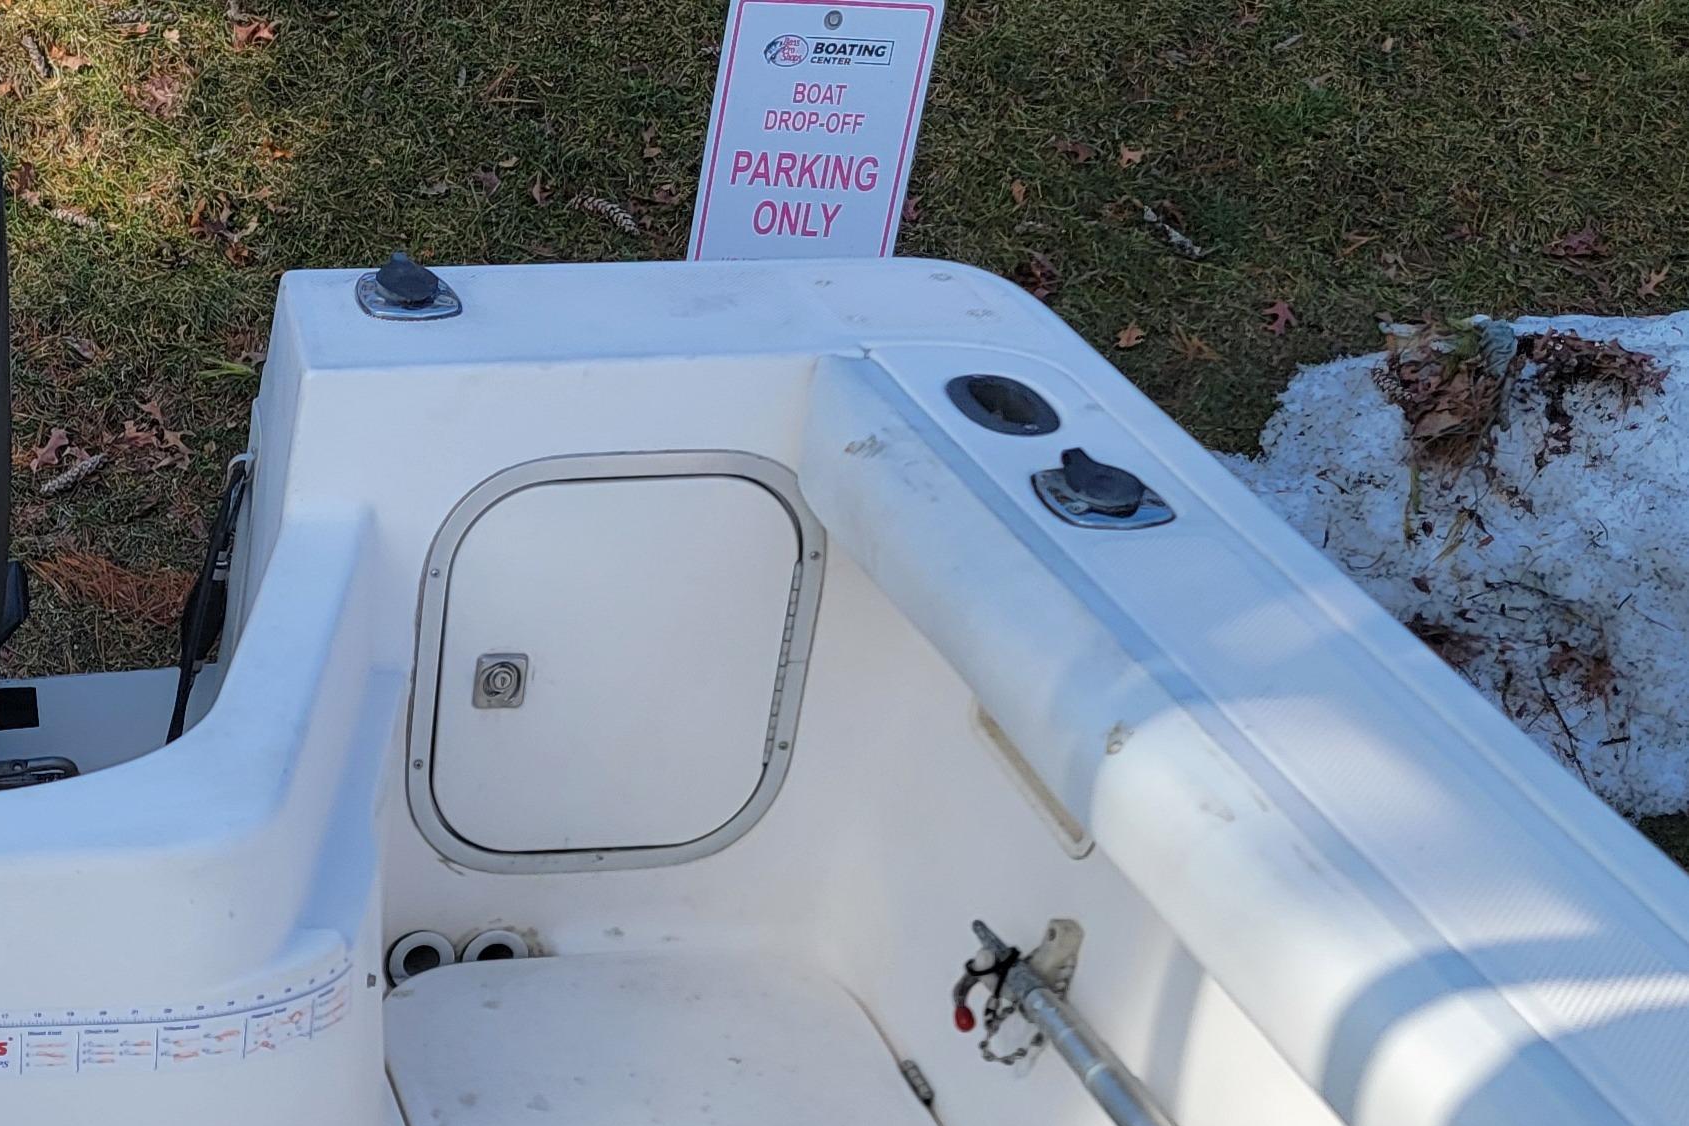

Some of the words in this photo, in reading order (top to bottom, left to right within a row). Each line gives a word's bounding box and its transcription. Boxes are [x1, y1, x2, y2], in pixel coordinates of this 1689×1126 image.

[811, 56, 851, 65] CENTER
[813, 42, 888, 58] BOATING
[792, 82, 848, 105] BOAT
[764, 110, 865, 134] DROP-OFF
[730, 150, 879, 192] PARKING
[752, 200, 842, 238] ONLY
